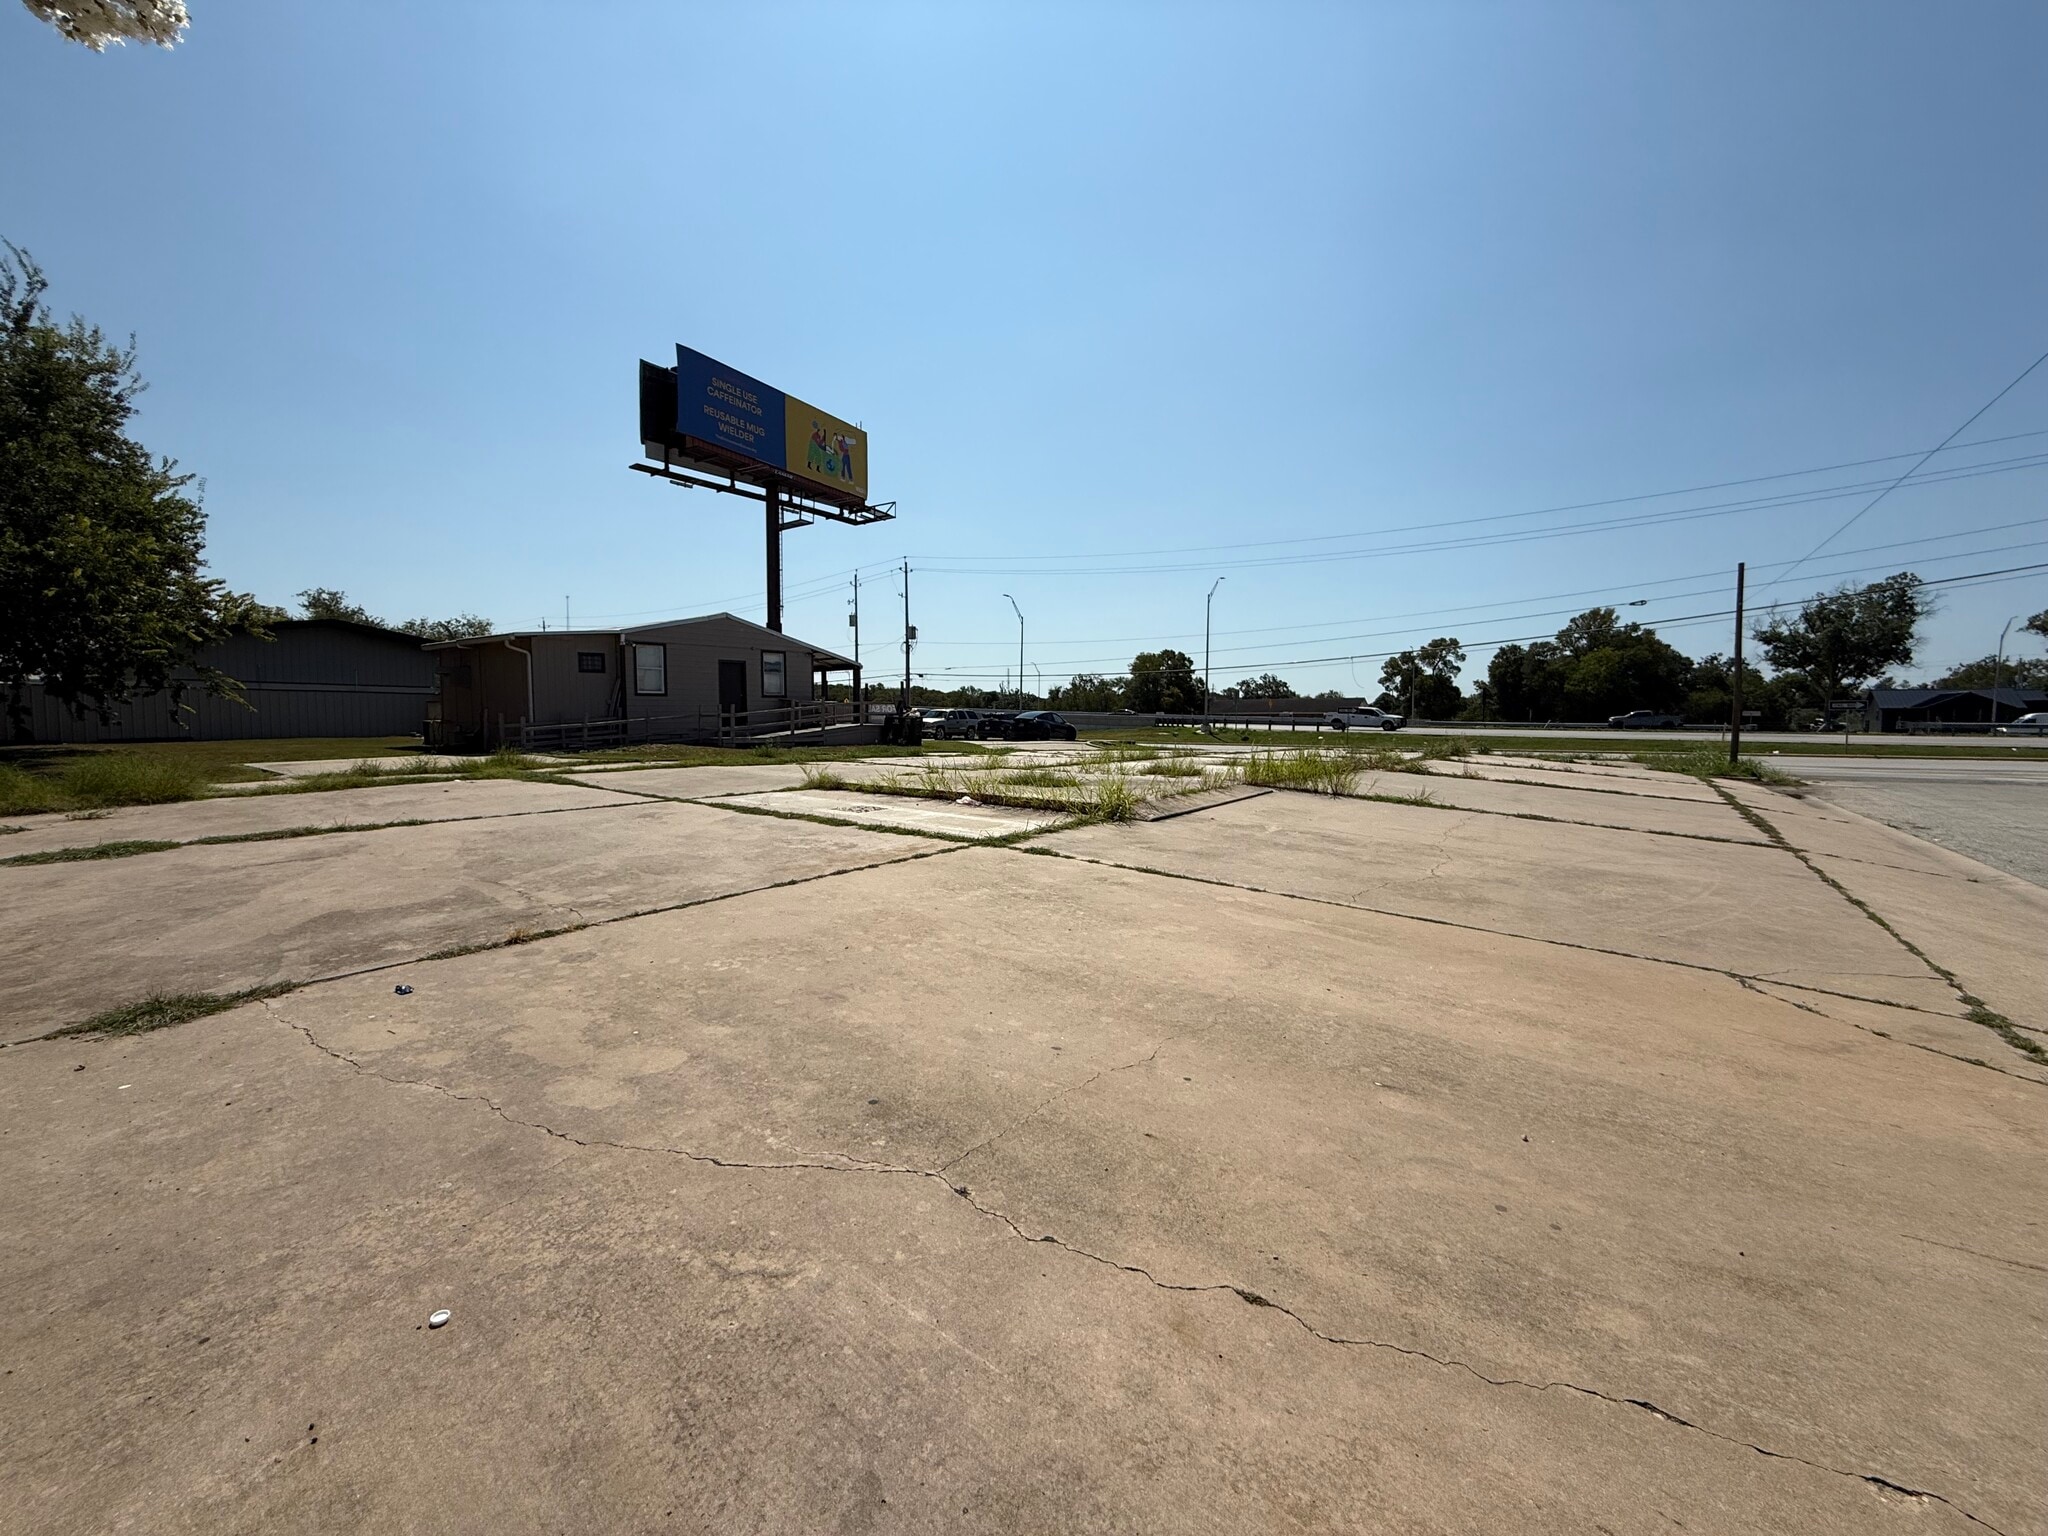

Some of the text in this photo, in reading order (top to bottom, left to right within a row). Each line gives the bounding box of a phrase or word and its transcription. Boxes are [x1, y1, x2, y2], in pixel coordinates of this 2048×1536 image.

[707, 386, 762, 416] CAFFEINATOR
[712, 377, 757, 404] SINGLE USE
[704, 405, 765, 437] REUSABLE MUG
[718, 421, 754, 442] WIELDER
